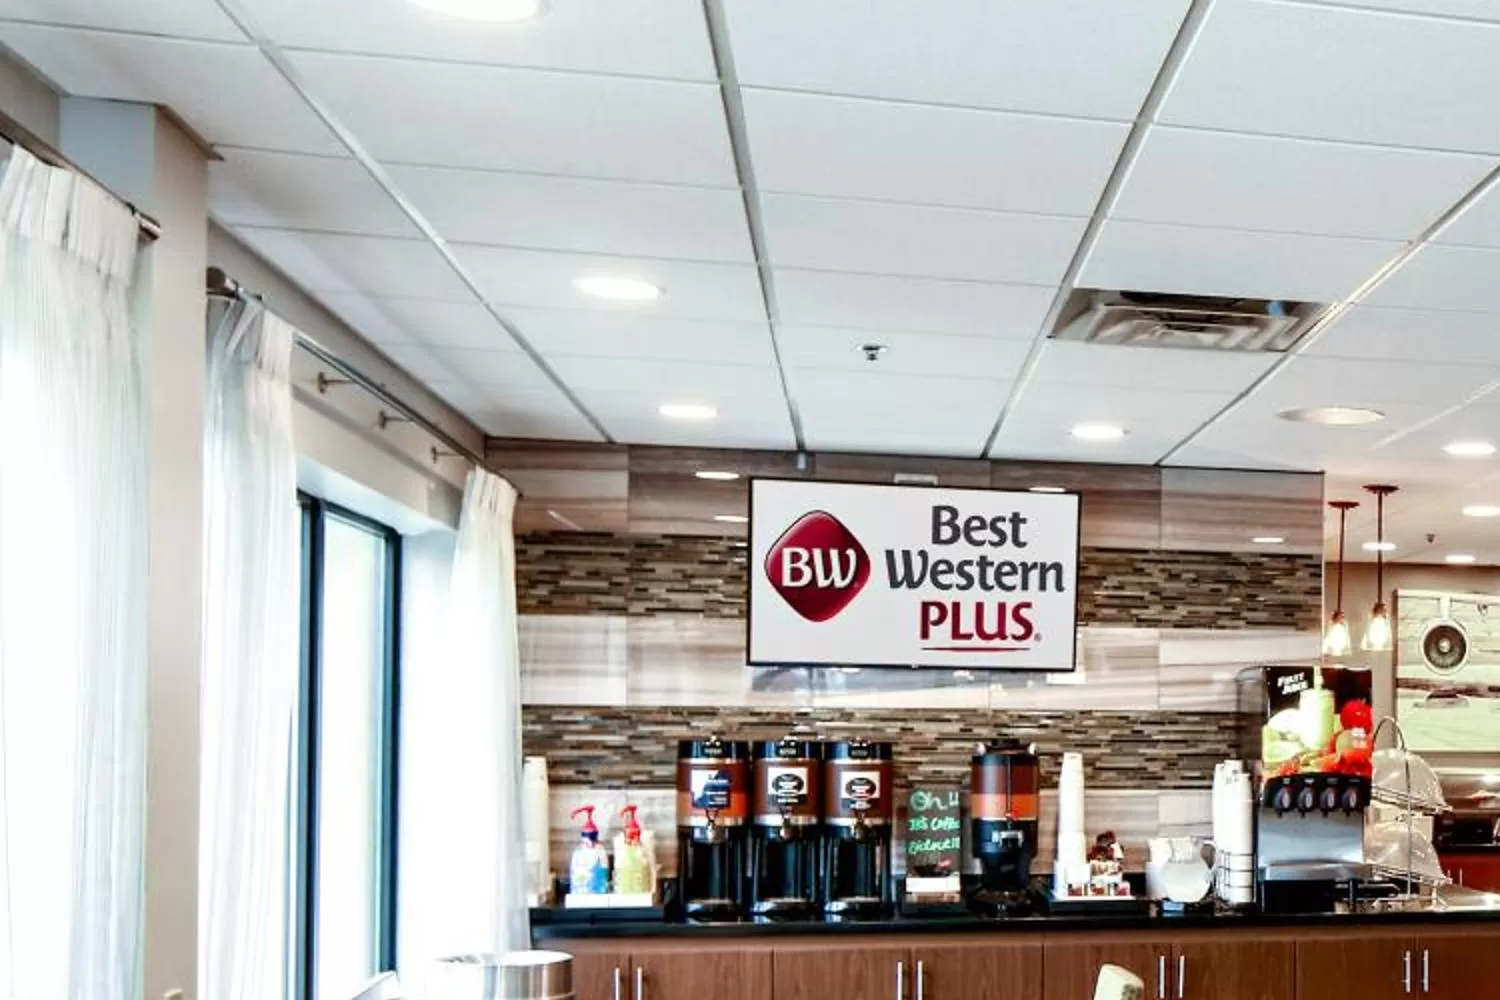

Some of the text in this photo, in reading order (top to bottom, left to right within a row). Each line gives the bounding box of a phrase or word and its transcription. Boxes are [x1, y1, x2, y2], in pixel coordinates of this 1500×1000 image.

[931, 505, 1028, 548] Best
[781, 547, 857, 590] BW
[885, 549, 1065, 592] Western
[920, 601, 1035, 641] PLUS
